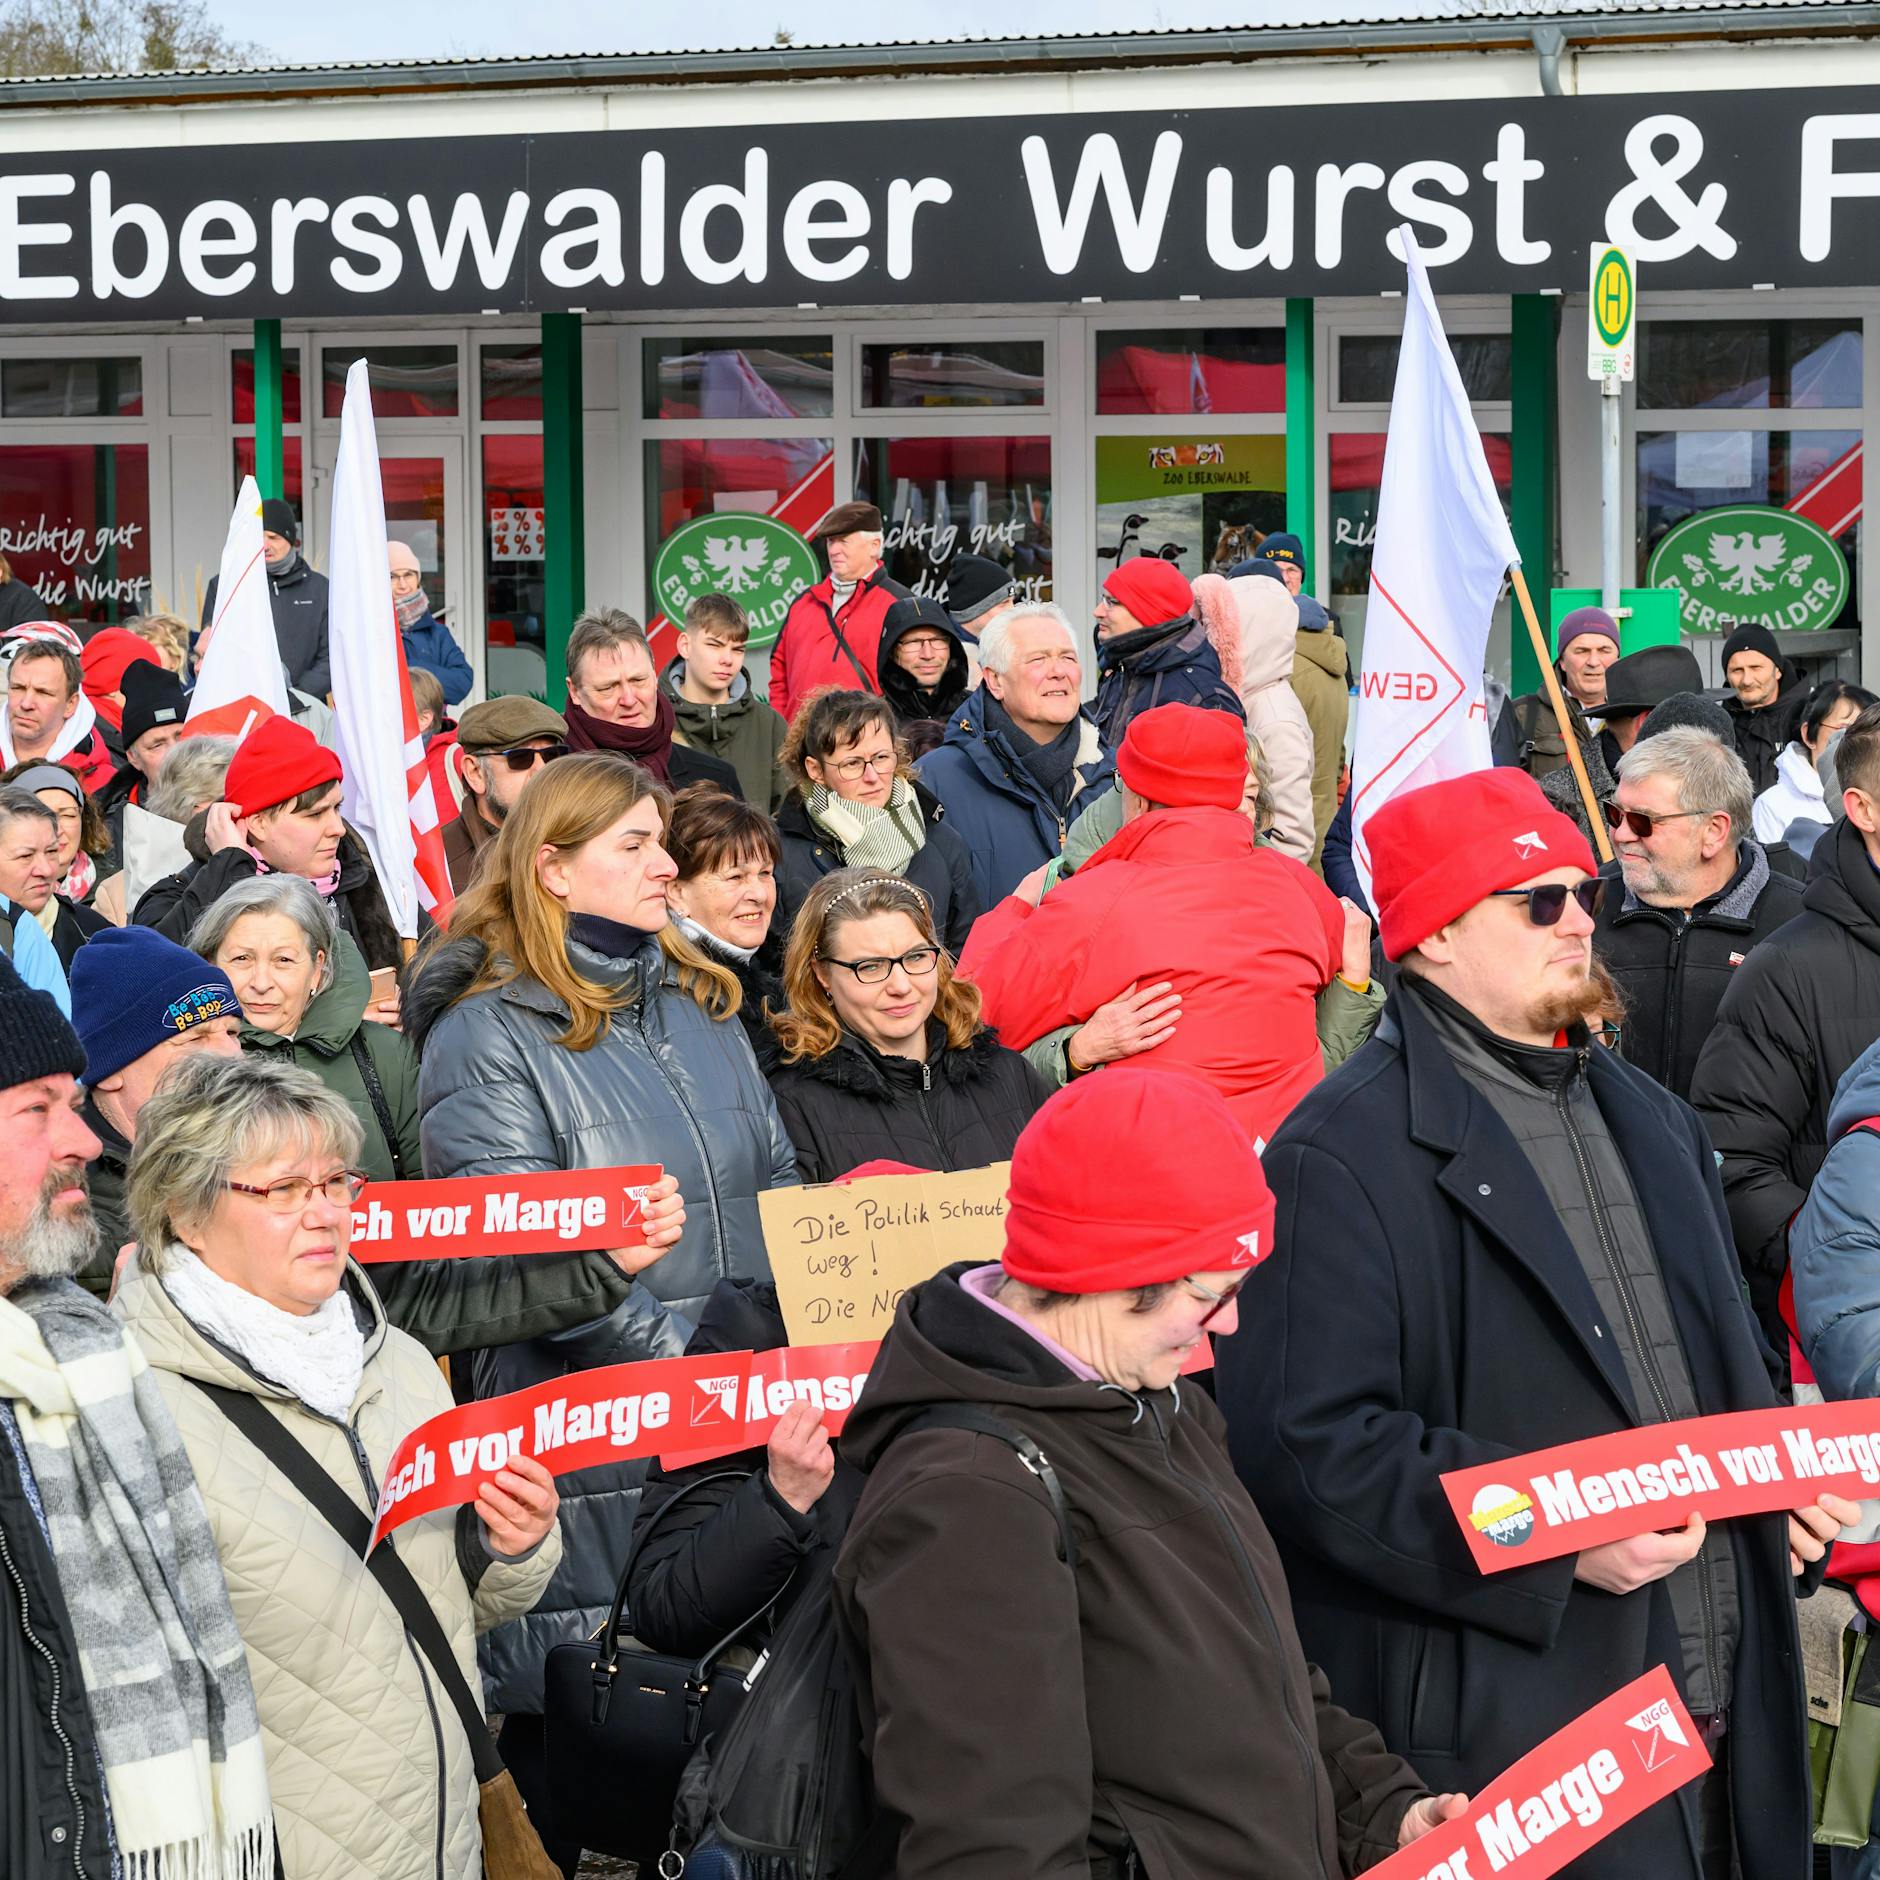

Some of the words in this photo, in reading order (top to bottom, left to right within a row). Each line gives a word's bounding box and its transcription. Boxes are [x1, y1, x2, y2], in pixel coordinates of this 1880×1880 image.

[0, 146, 953, 300] Eberswalder
[1021, 122, 1552, 274] Wurst
[1604, 114, 1738, 262] &
[1605, 271, 1621, 325] H
[1163, 472, 1184, 485] ZOO
[1188, 471, 1252, 484] EBERSWALDE
[0, 513, 86, 565] Richtig
[84, 523, 142, 564] gut
[883, 508, 959, 564] chtig
[958, 518, 1026, 555] gut
[75, 574, 151, 603] Wurst
[406, 1204, 472, 1239] vor
[483, 1191, 606, 1240] Marge
[793, 1213, 850, 1244] Die
[805, 1297, 856, 1324] Die
[709, 1378, 738, 1392] NGG
[381, 1443, 436, 1516] sch
[448, 1424, 524, 1478] vor
[534, 1390, 671, 1456] Marge
[1529, 1443, 1720, 1527] Mensch
[1717, 1443, 1784, 1487] vor
[1640, 1702, 1670, 1728] NGG
[1474, 1748, 1625, 1873] Marge
